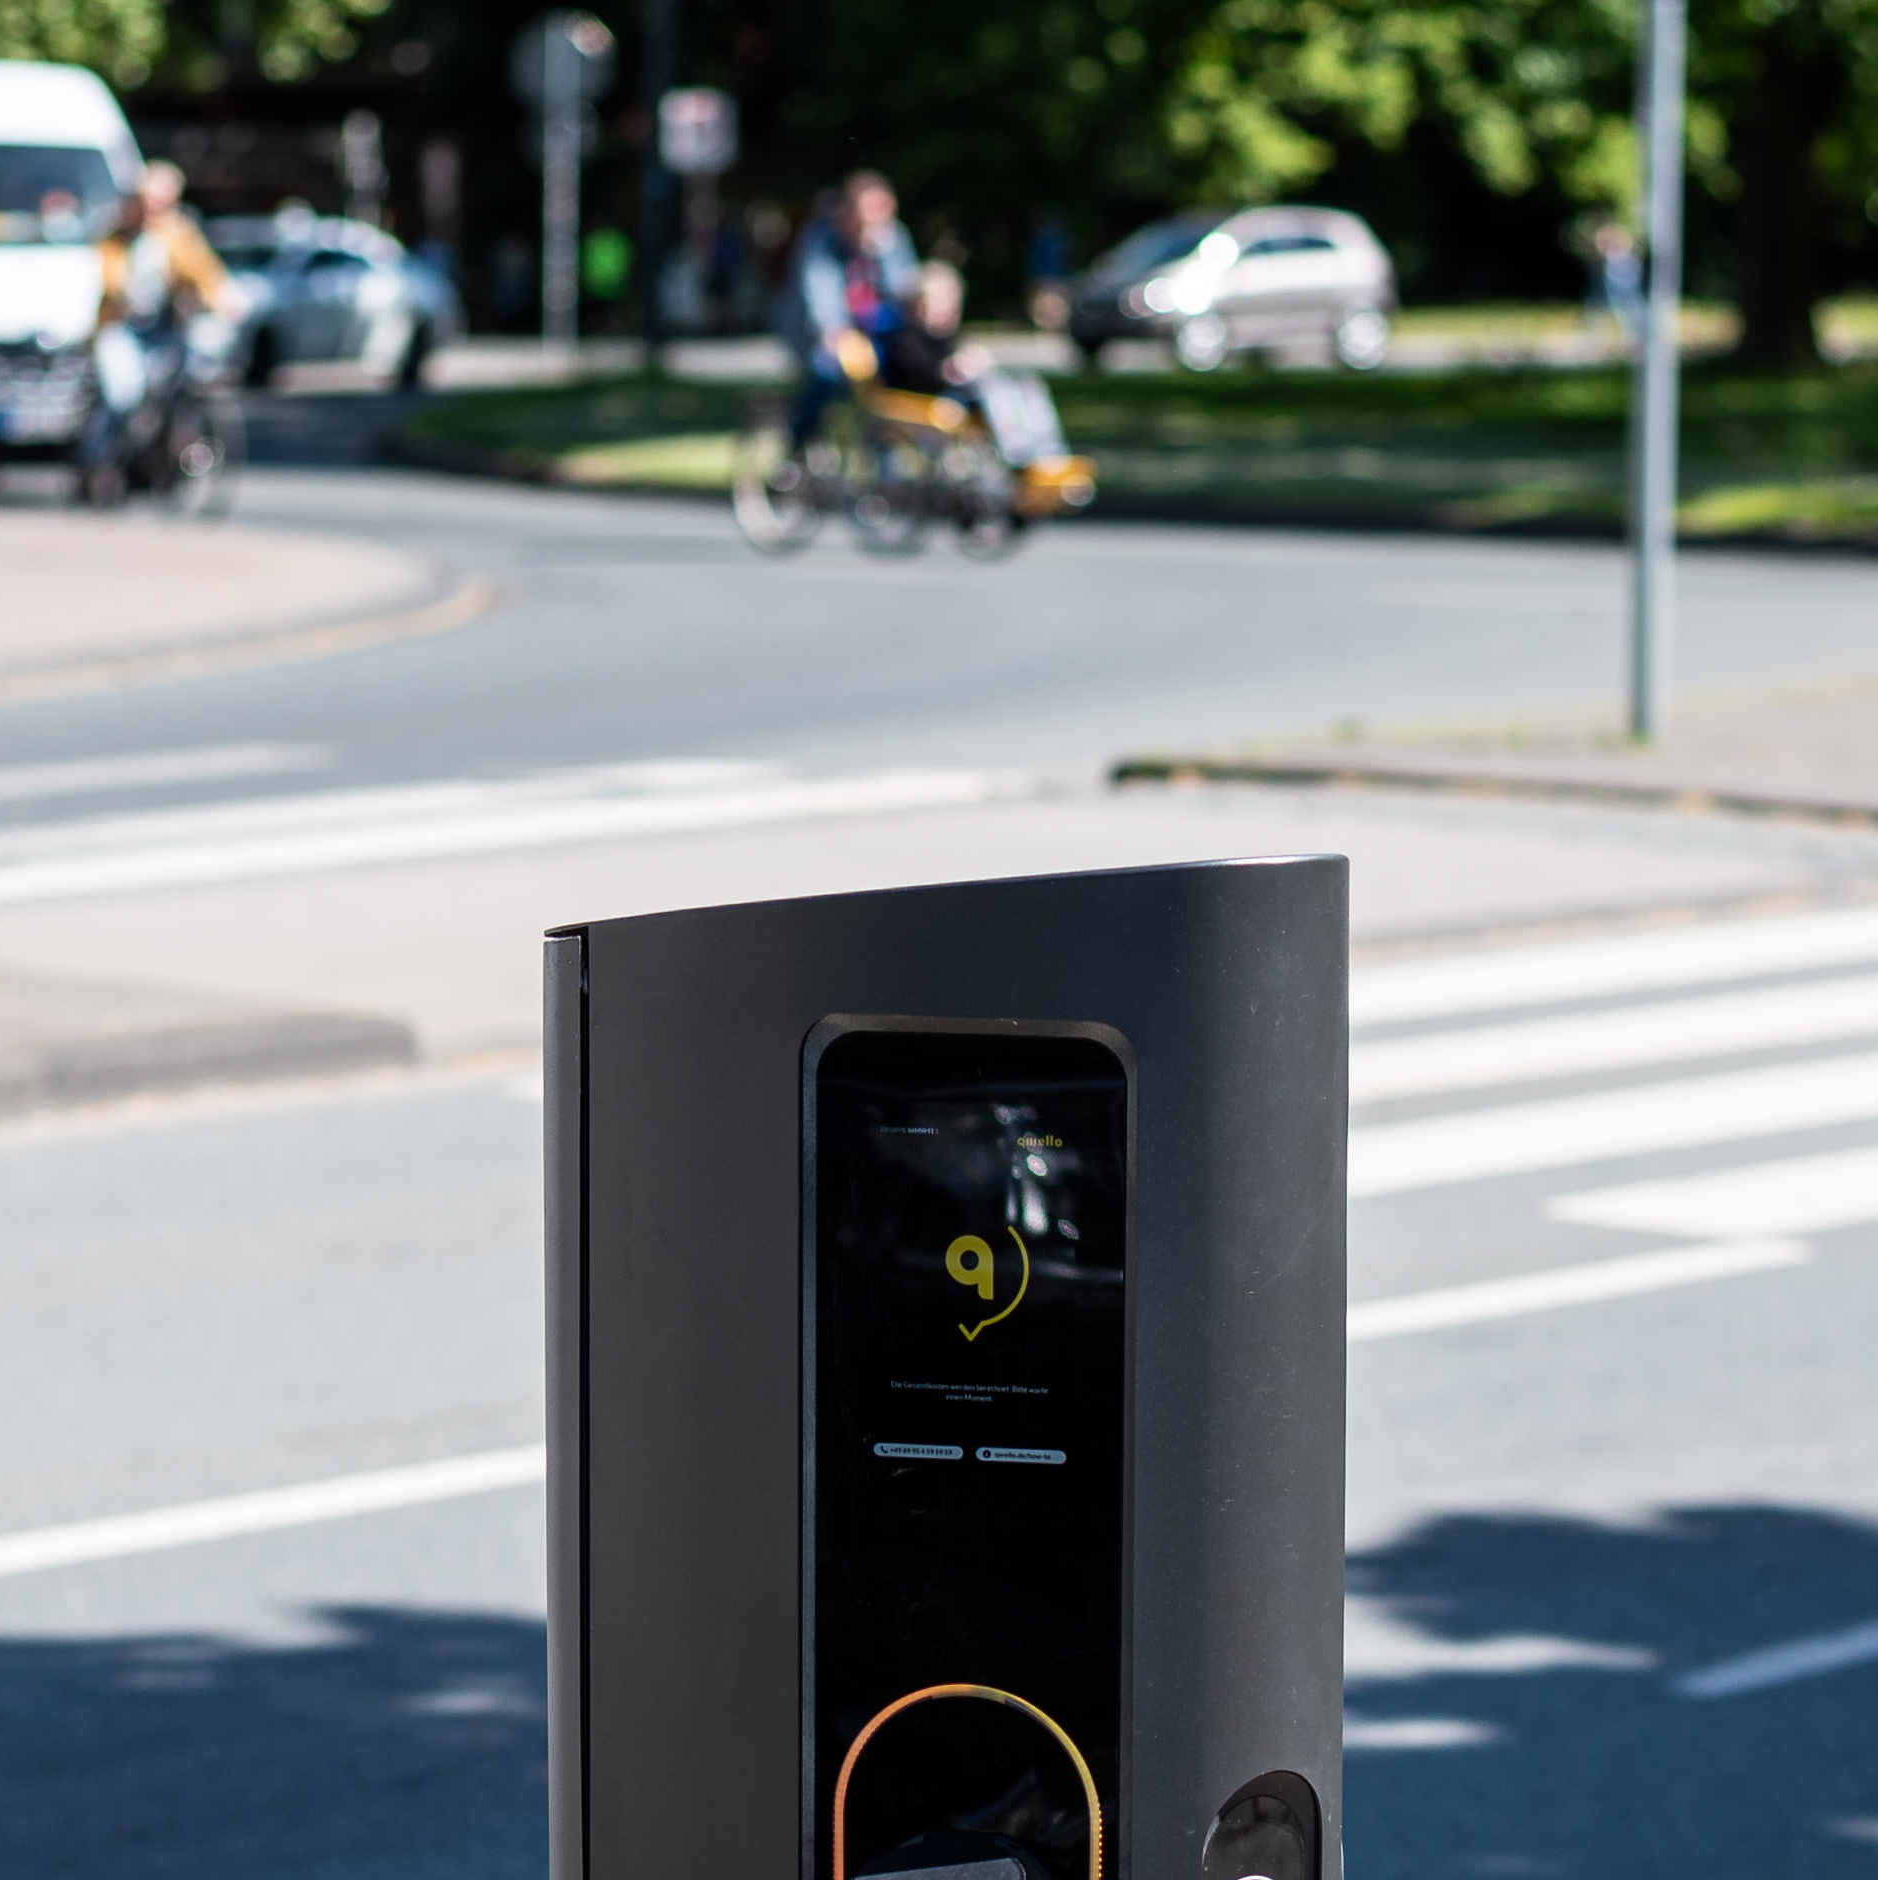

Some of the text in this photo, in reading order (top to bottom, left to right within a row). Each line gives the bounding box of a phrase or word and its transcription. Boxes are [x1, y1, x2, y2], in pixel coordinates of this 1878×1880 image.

[890, 1380, 902, 1389] Die
[903, 1381, 950, 1391] Gesamtkosten
[950, 1383, 975, 1391] werden
[1011, 1385, 1027, 1393] Bitte
[1028, 1386, 1049, 1395] warte
[945, 1394, 964, 1402] einen
